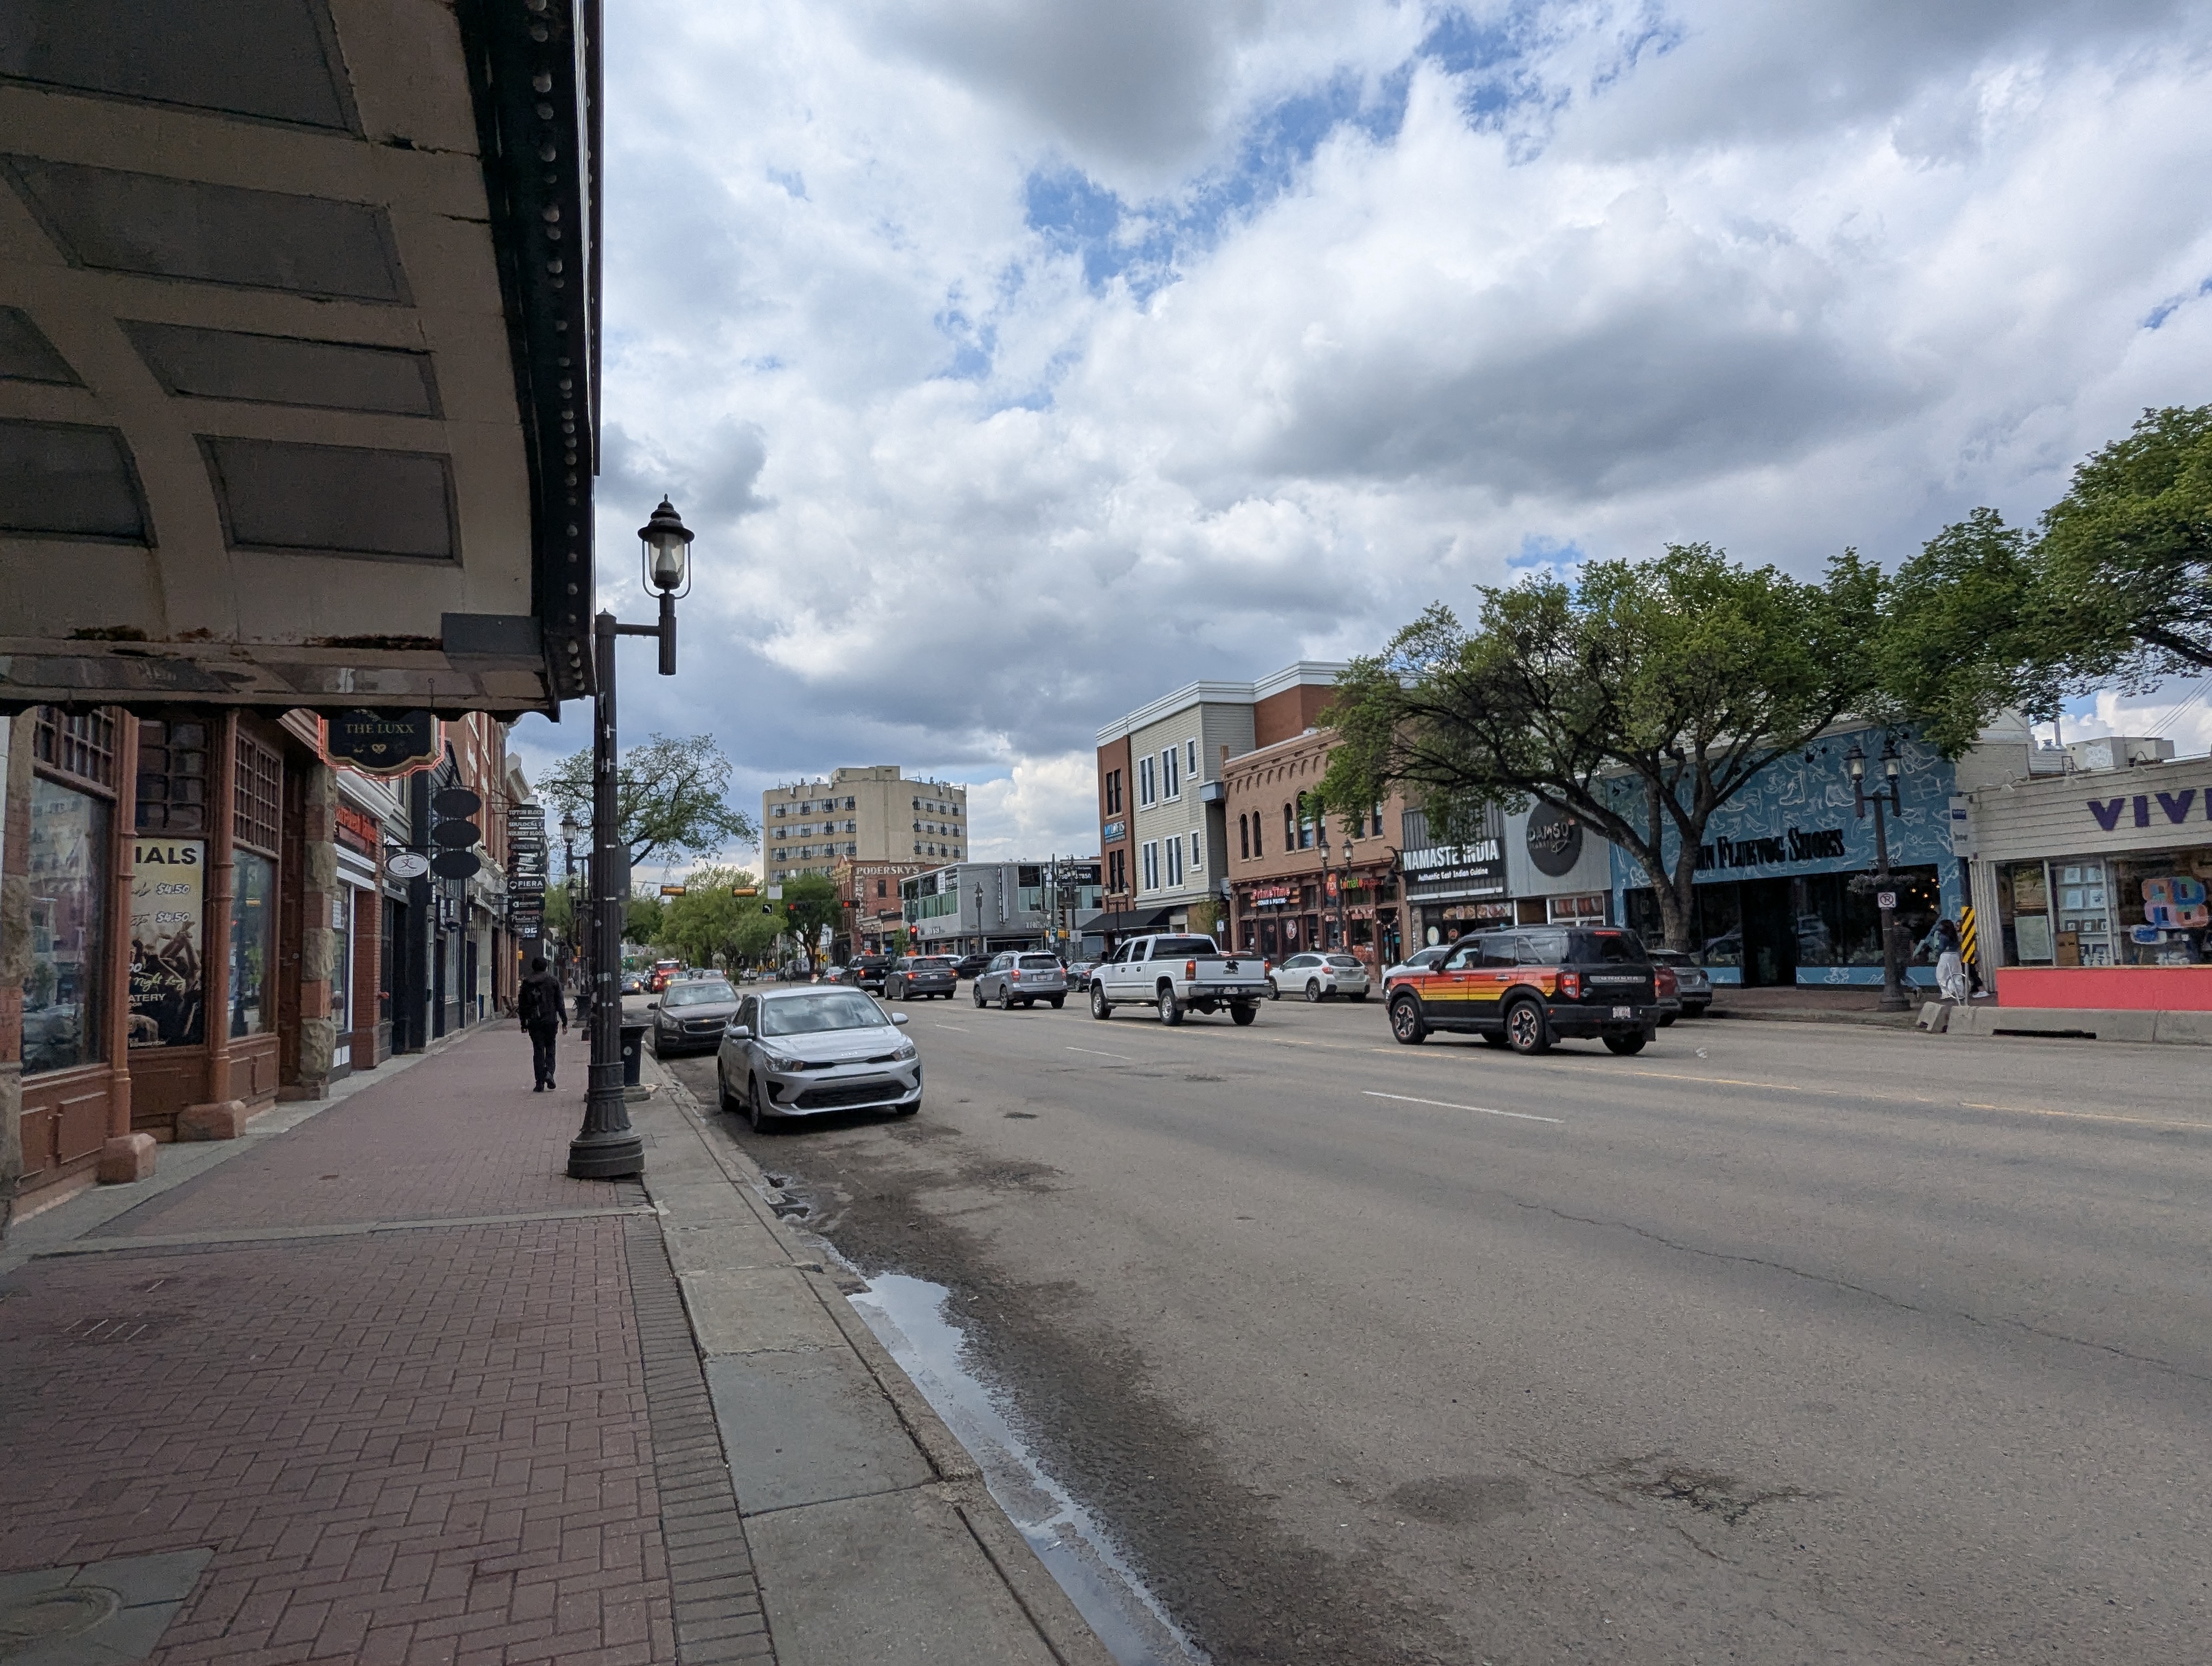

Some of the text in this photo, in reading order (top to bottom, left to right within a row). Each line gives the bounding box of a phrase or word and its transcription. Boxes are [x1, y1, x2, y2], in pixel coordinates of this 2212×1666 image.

[345, 724, 415, 734] THE LUXX
[1403, 839, 1500, 871] NAMASTE INDIA
[1418, 873, 1440, 882] Authentic
[1441, 871, 1451, 879] East
[1453, 869, 1469, 877] Indian
[156, 883, 190, 895] $4.50
[156, 911, 190, 923] $4.50
